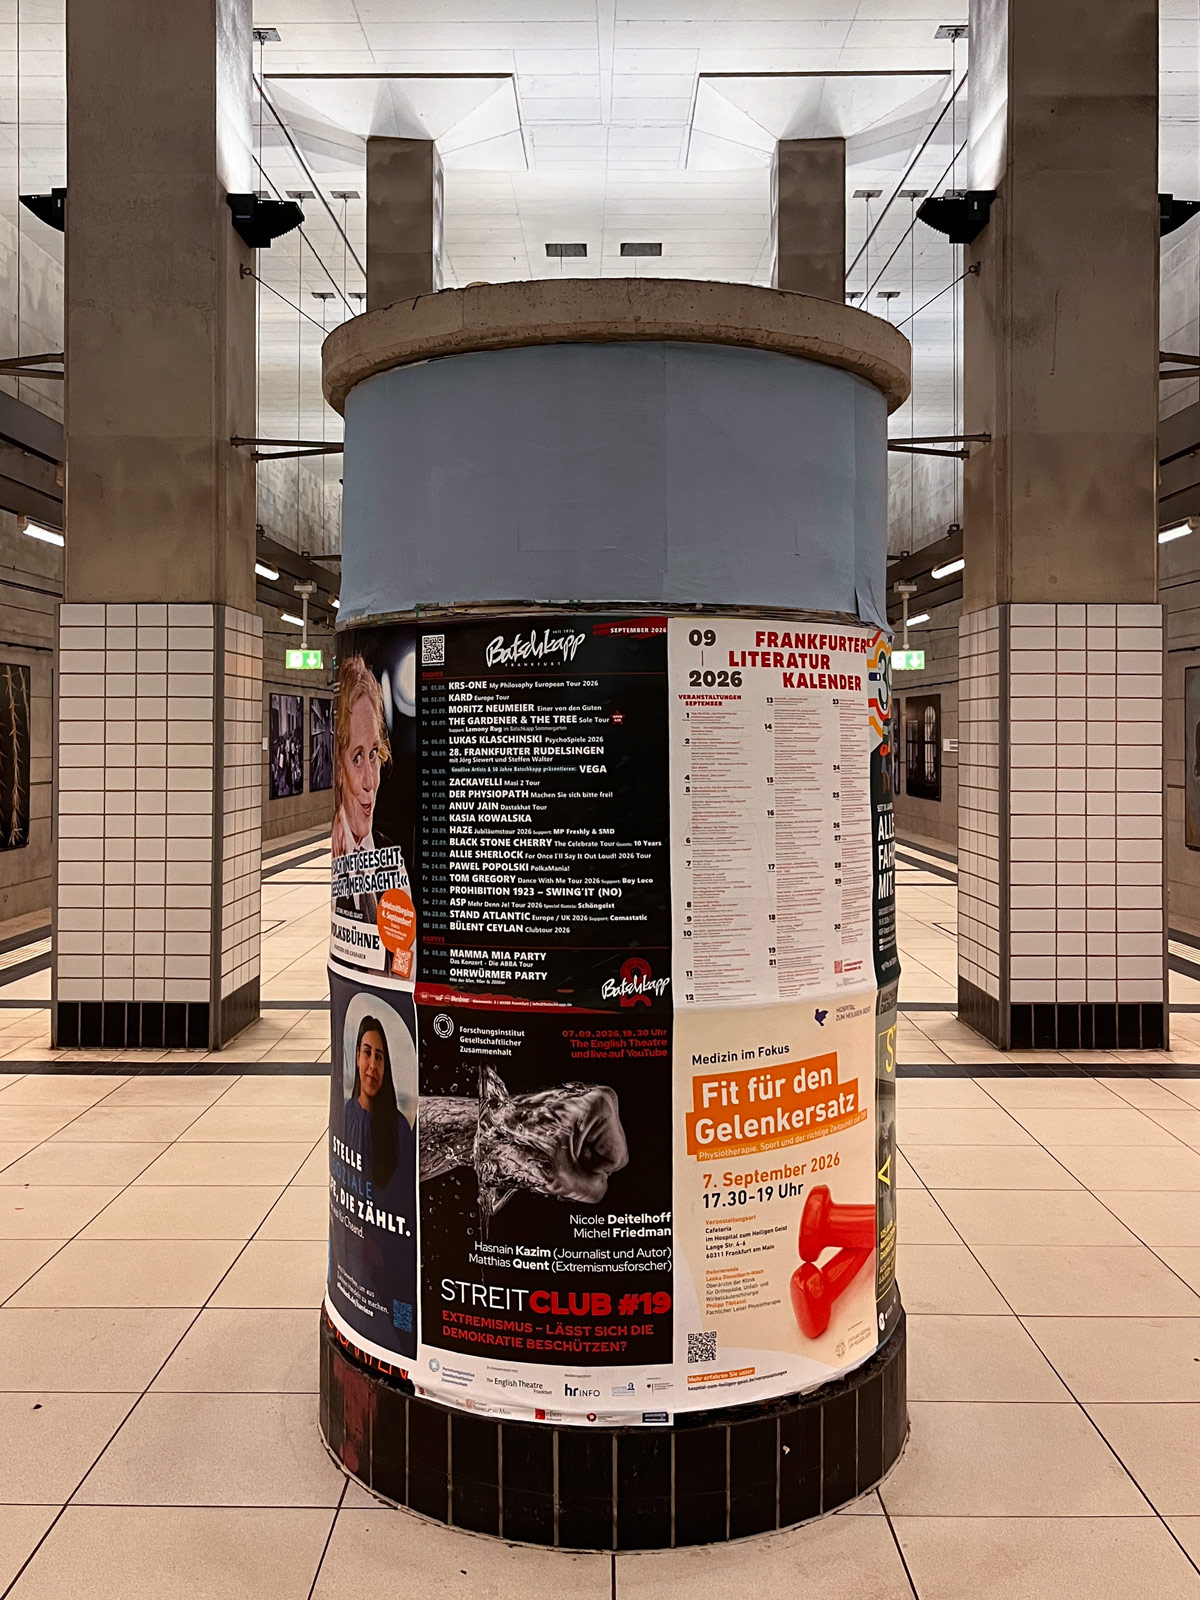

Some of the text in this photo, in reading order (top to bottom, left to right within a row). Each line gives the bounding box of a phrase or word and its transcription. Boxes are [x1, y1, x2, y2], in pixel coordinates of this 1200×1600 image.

[688, 629, 716, 646] 09
[755, 631, 867, 653] FRANKFURTER
[486, 628, 586, 668] Batschkapp
[729, 651, 830, 670] LITERATUR
[689, 670, 742, 687] 2026
[782, 672, 862, 691] KALENDER
[448, 681, 487, 690] KRS-ONE
[448, 693, 473, 702] KARD
[449, 704, 534, 714] MORITZ NEUMEIER
[449, 717, 465, 726] THE
[468, 716, 517, 725] GARDENER
[530, 716, 550, 724] THE
[449, 736, 477, 744] LUKAS
[479, 735, 542, 744] KLASCHINSKI
[449, 747, 604, 756] 28. FRANKFURTER RUDELSINGEN
[579, 765, 607, 773] VEGA
[449, 778, 502, 786] ZACKAVELLI
[449, 790, 529, 798] DER PHYSIOPATH
[477, 802, 498, 810] JAIN
[478, 814, 532, 822] KOWALSKA
[450, 826, 473, 834] HAZE
[513, 839, 552, 847] CHERRY
[475, 851, 524, 859] SHERLOCK
[450, 862, 480, 870] PAWEL
[482, 863, 529, 871] POPOLSKI
[472, 875, 516, 883] GREGORY
[450, 886, 510, 895] PROHIBITION
[598, 888, 622, 897] (NO)
[450, 910, 480, 919] STAND
[483, 911, 530, 920] ATLANTIC
[450, 922, 524, 932] BÜLENT CEYLAN
[332, 923, 379, 950] OLKSBÜHNE
[450, 950, 546, 961] MAMMA MIA PARTY
[450, 968, 547, 980] OHRWÜRMER PARTY
[459, 1026, 525, 1037] Forschungsinstitut
[562, 1030, 621, 1038] 07.09.2026,
[459, 1036, 521, 1047] Gesellschaftlicher
[591, 1039, 627, 1048] English
[629, 1038, 667, 1046] Theatre
[459, 1046, 512, 1056] Zusammenhalt
[627, 1049, 668, 1057] YouTube
[692, 1045, 790, 1065] Medizin im Fokus
[702, 1067, 832, 1108] Fit für den
[695, 1092, 854, 1144] Gelenkersatz
[699, 1146, 759, 1160] Physiotherapie,
[760, 1140, 780, 1152] Sport
[781, 1138, 794, 1147] und
[795, 1134, 806, 1143] der
[807, 1128, 828, 1142] richtige
[332, 1135, 362, 1171] STELLE
[703, 1152, 840, 1189] 7. September 2026
[332, 1157, 372, 1200] SOZIALE
[703, 1182, 804, 1208] 17.30-19 Uhr
[340, 1188, 355, 1213] DIE
[358, 1200, 411, 1237] ZÄHLT.
[570, 1212, 671, 1225] Nicole Deitelhoff
[705, 1215, 756, 1225] Veranstaltungsort
[574, 1228, 671, 1238] Michel Friedman
[752, 1229, 773, 1237] Heiligen
[475, 1241, 672, 1260] Hasnain Kazim (Journalist und Autor)
[726, 1249, 752, 1257] Frankfurt
[469, 1253, 672, 1273] Matthias Quent (Extremismusforscher)
[441, 1278, 672, 1316] STREITCLUB #19
[442, 1310, 654, 1336] EXTREMISMUS LÄSST SICH DIE
[442, 1325, 627, 1352] DEMOKRATIE BESCHÜTZEN?
[495, 1378, 543, 1389] English Theatre
